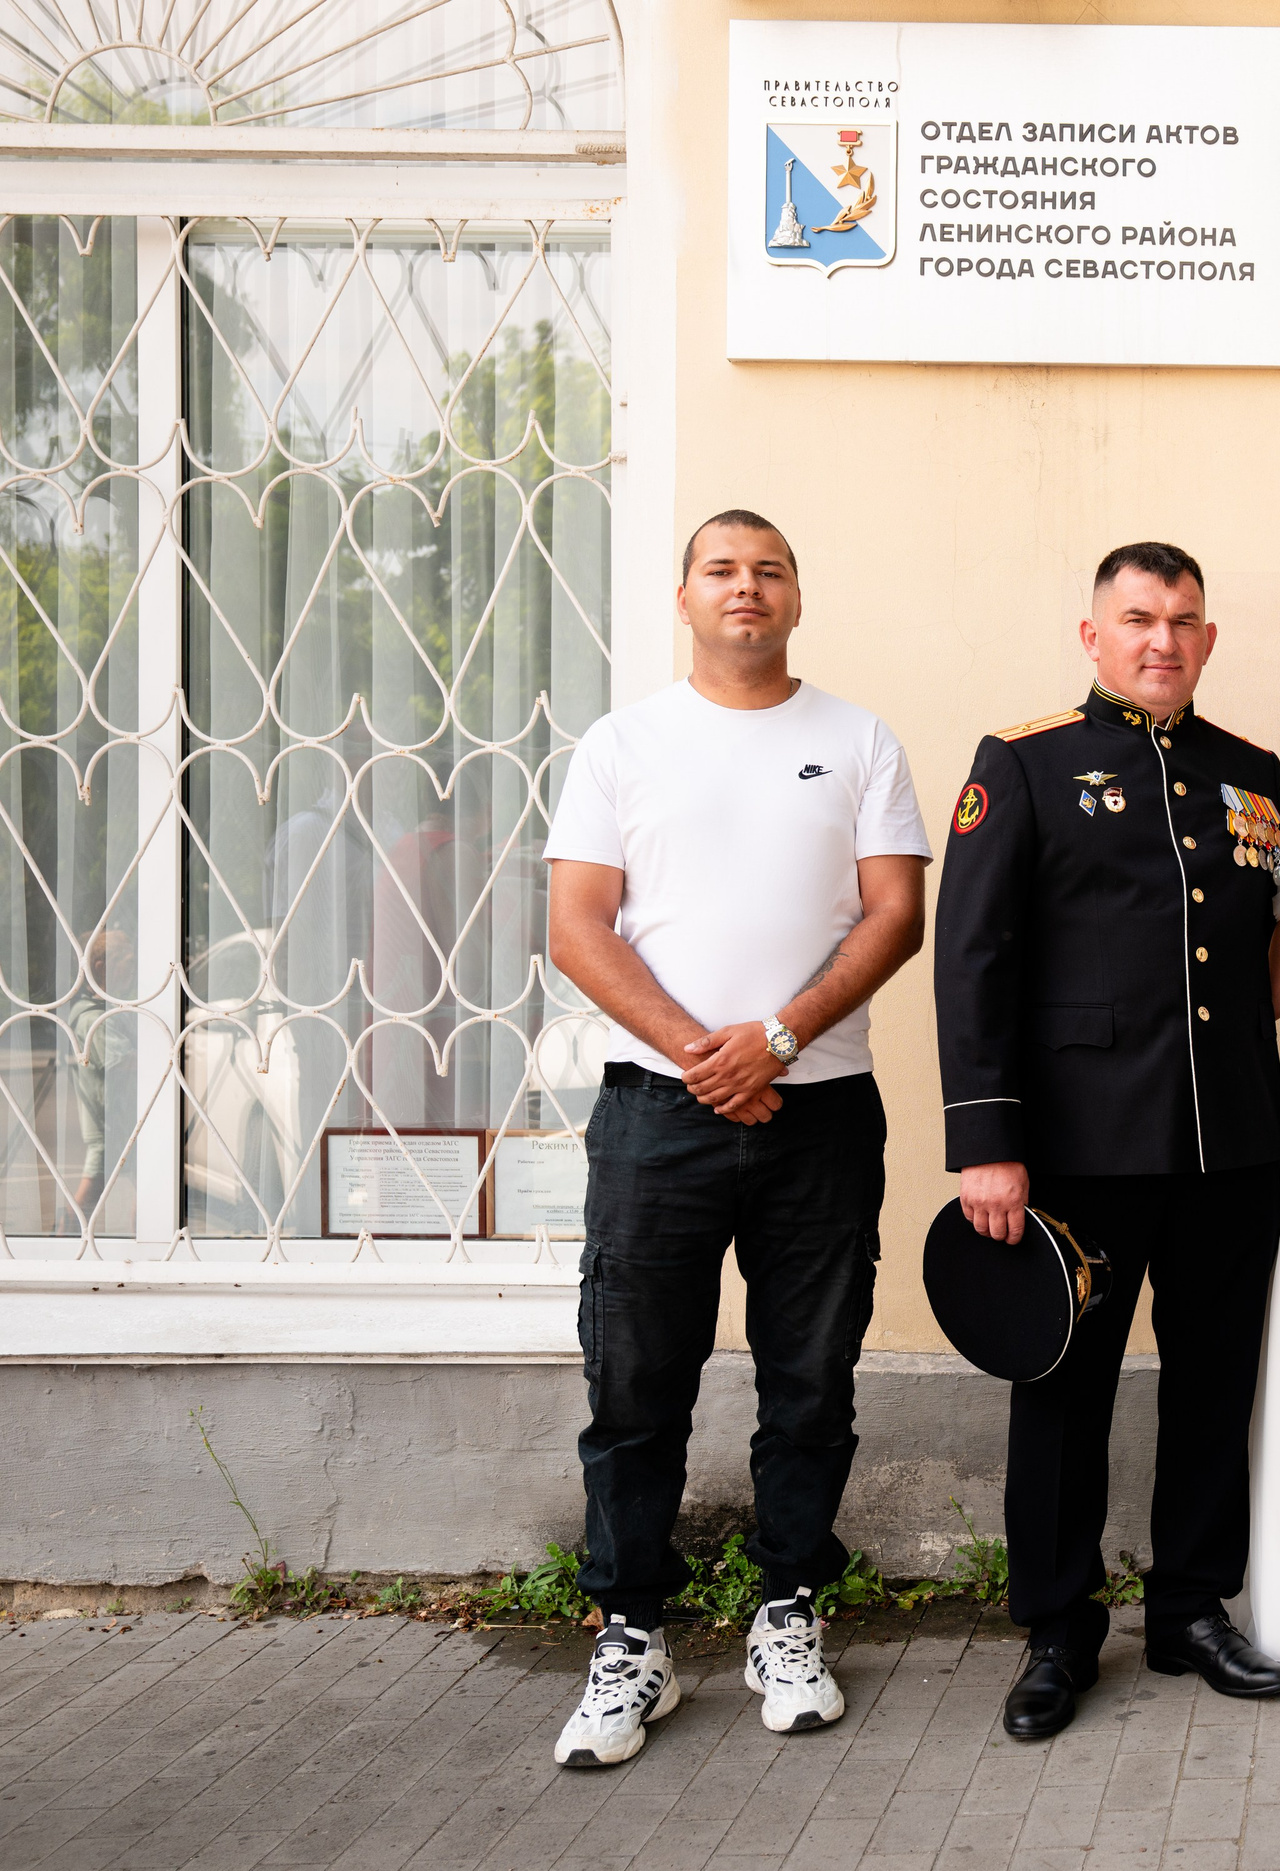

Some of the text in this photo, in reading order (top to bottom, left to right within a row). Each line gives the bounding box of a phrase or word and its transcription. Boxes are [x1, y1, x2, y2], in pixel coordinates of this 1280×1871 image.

[764, 80, 899, 93] ПРАВИТЕЛЬСТВО
[768, 95, 892, 108] СЕВАСТОПОЛЯ
[920, 120, 1239, 145] ОТДЕЛ ЗАПИСИ АКТОВ
[920, 155, 1157, 178] ГРАЖДАНСКОГО
[919, 188, 1096, 210] СОСТОЯНИЯ
[919, 220, 1237, 247] ЛЕНИНСКОГО РАЙОНА
[920, 256, 1255, 281] ГОРОДА СЕВАСТОПОЛЯ
[803, 764, 824, 774] NIKE
[531, 1140, 568, 1150] Режим
